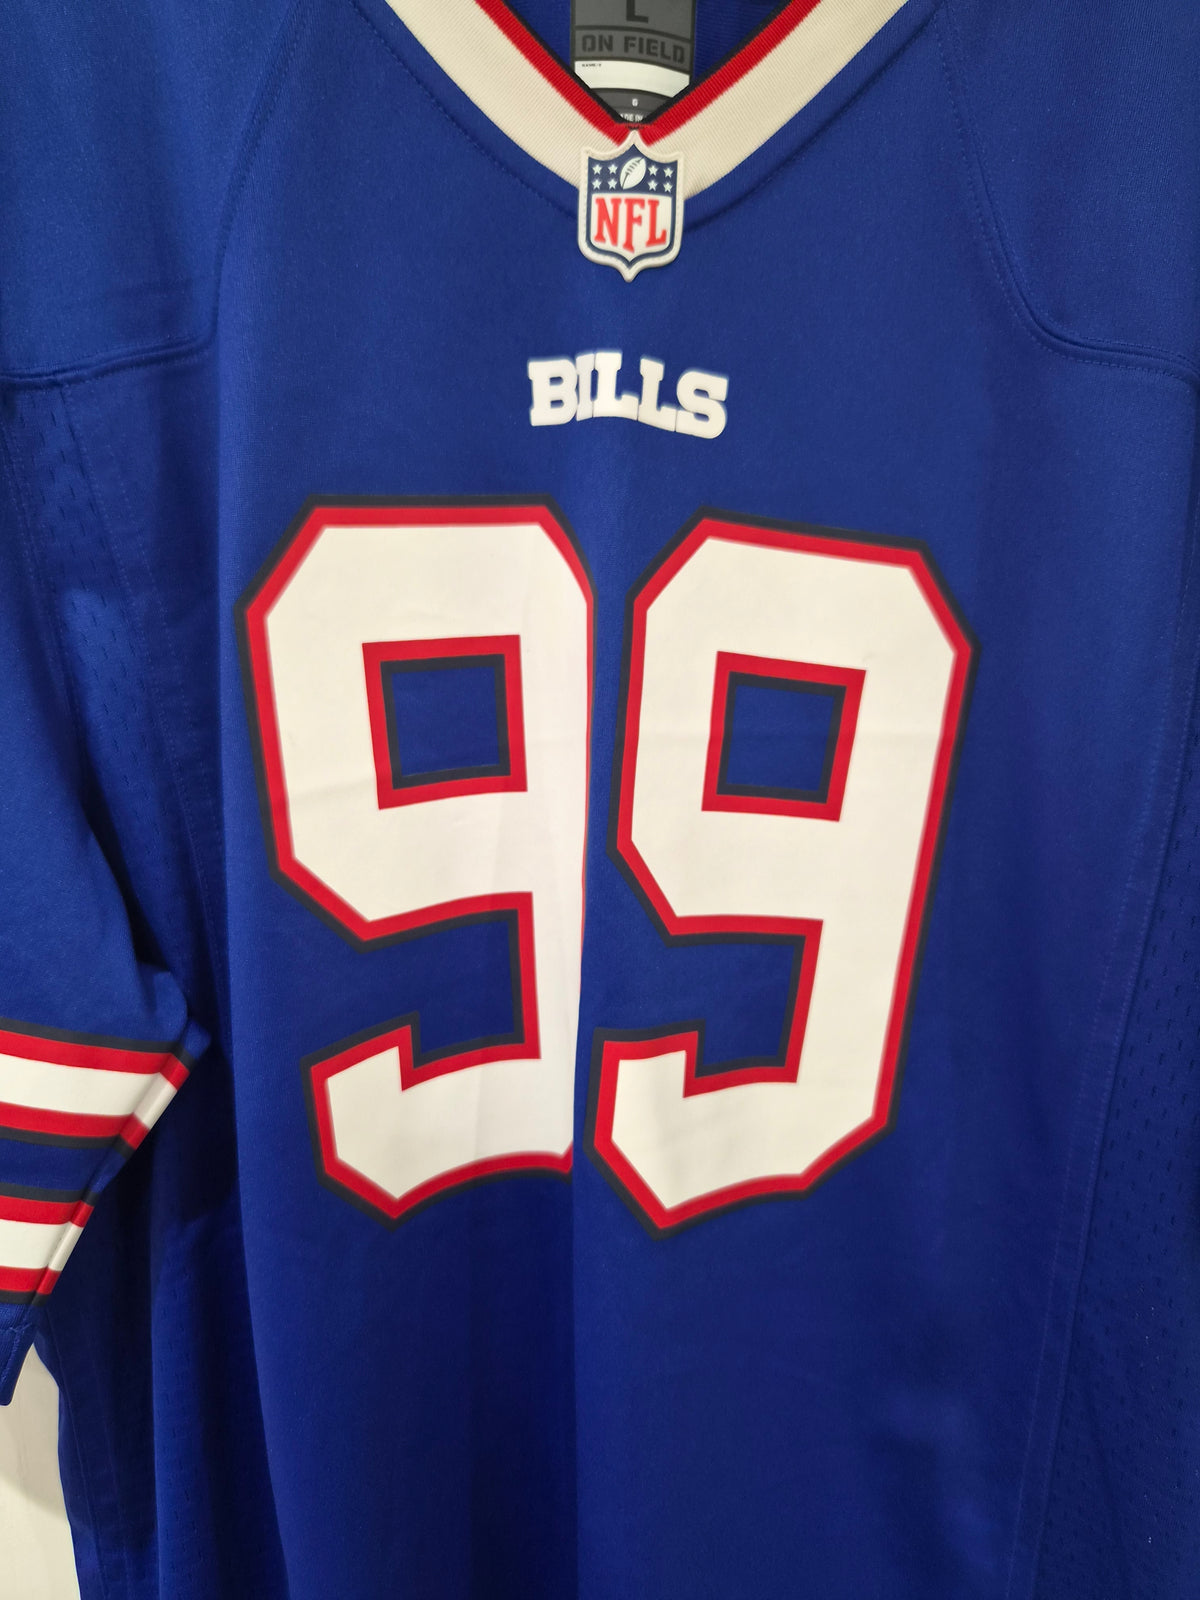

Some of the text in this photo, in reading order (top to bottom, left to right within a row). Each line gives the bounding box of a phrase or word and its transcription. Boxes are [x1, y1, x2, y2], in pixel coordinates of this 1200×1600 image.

[582, 35, 684, 64] ON FIELD
[594, 197, 667, 253] NFL
[528, 350, 729, 439] BILLS
[244, 496, 977, 1232] 99
